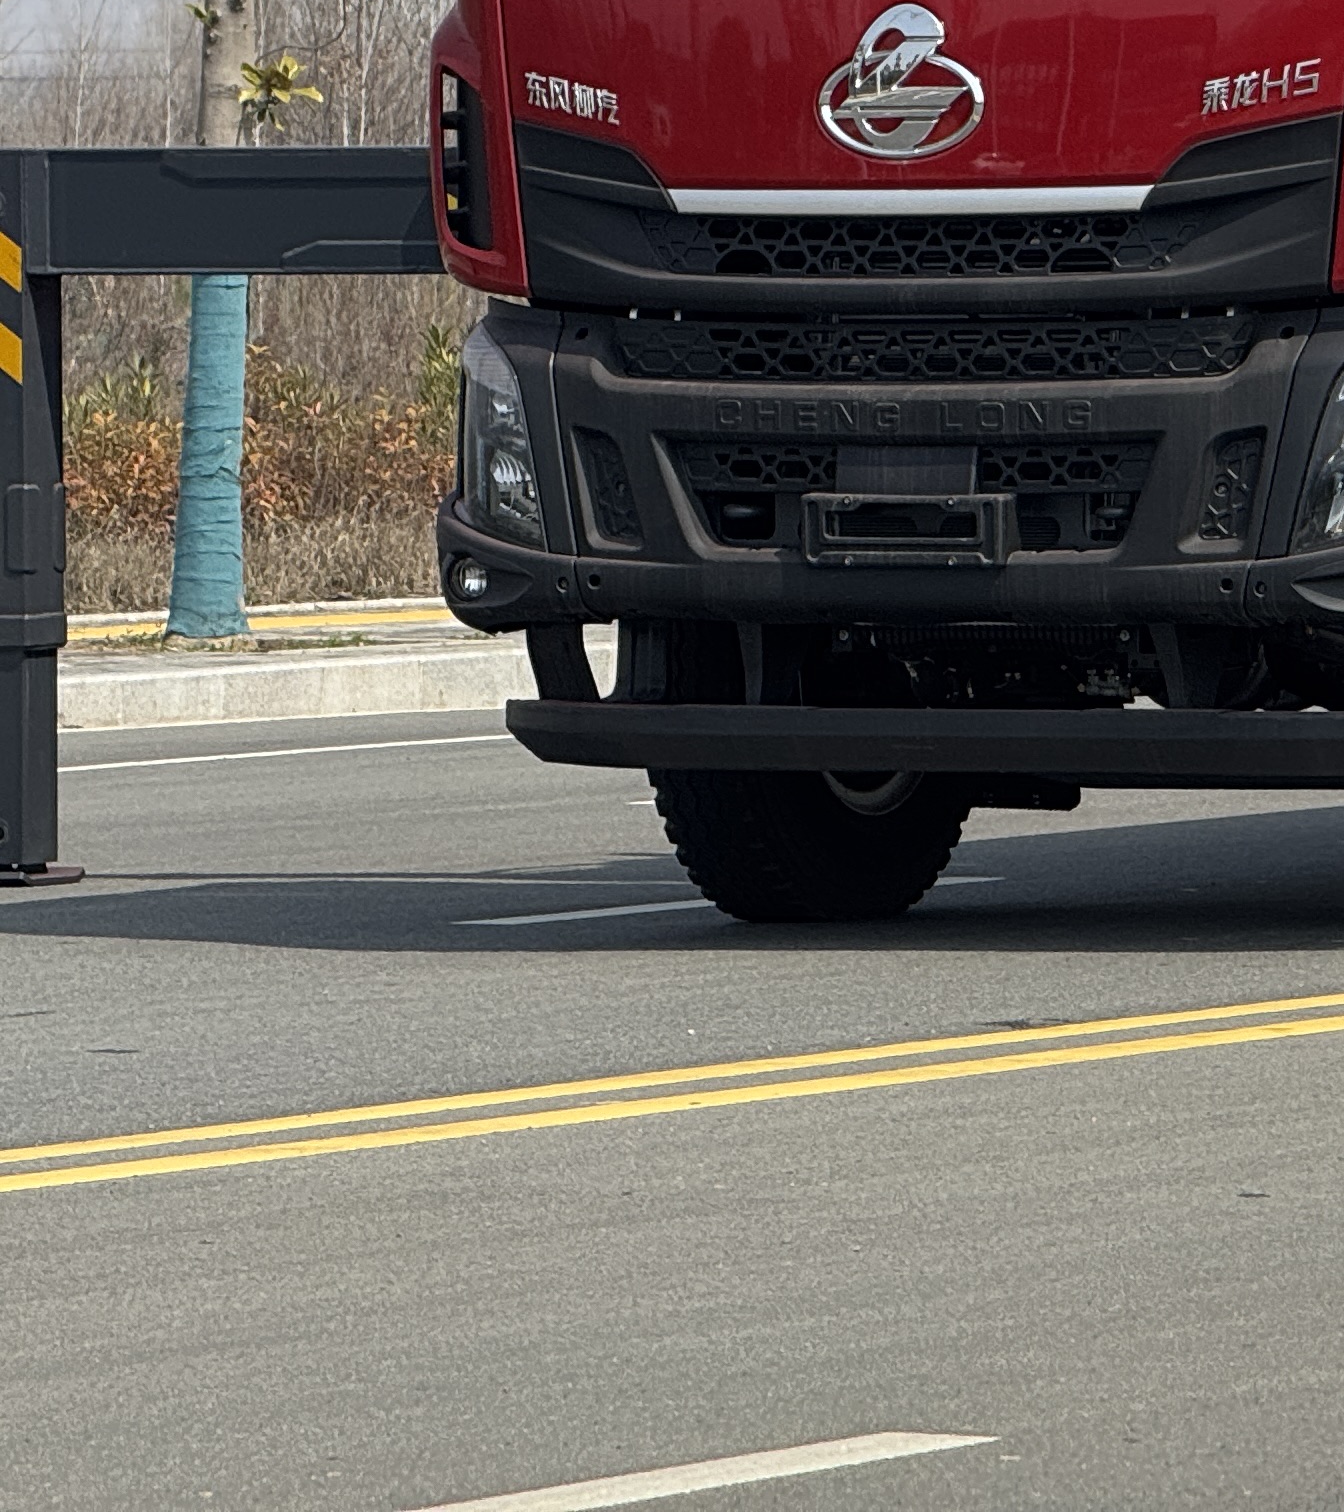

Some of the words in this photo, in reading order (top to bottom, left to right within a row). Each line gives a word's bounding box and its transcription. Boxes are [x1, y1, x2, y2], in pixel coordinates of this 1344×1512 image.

[524, 71, 621, 127] 东风柳汽
[1200, 57, 1322, 116] 乘龙H5
[714, 398, 900, 433] CHENG
[939, 398, 1093, 433] LONG
